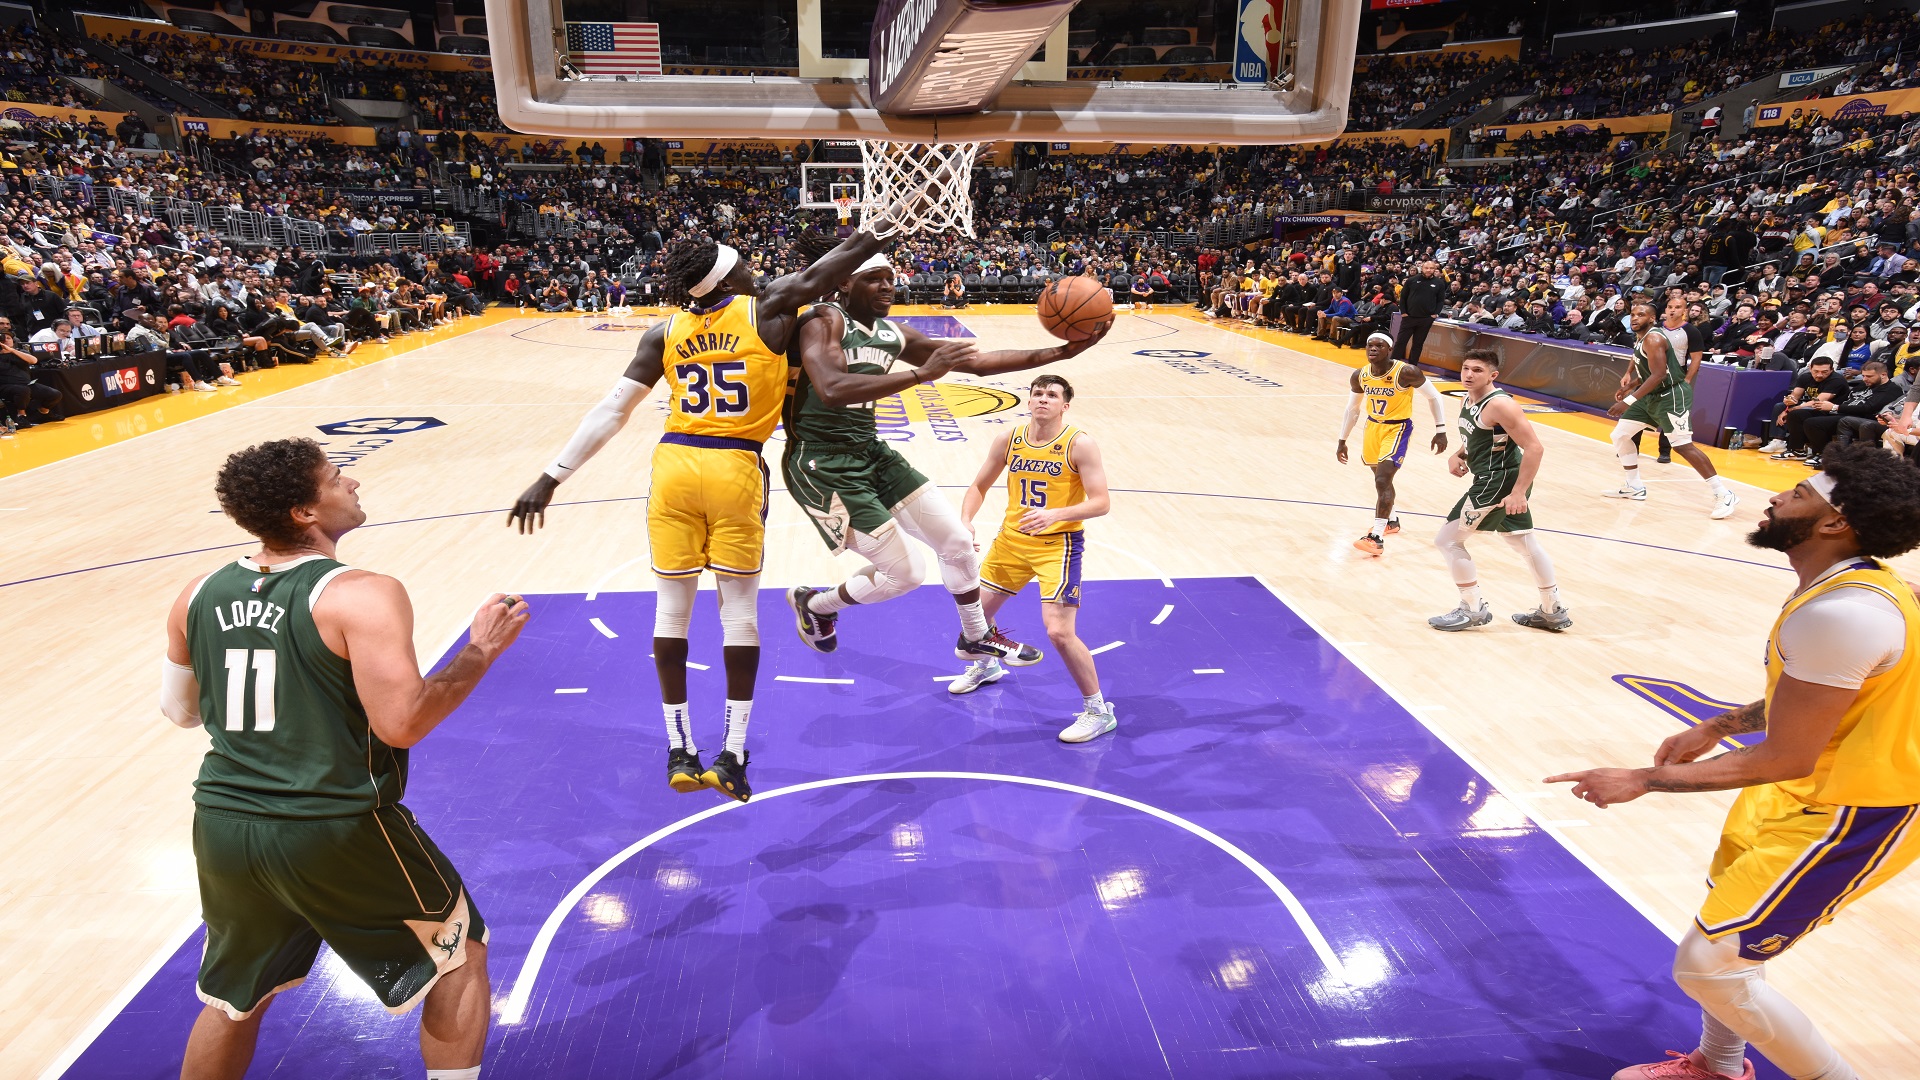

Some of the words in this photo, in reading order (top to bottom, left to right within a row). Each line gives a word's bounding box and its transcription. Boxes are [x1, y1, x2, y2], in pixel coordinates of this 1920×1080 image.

[219, 37, 319, 56] NGELES
[1240, 62, 1262, 78] NBA
[1791, 74, 1812, 83] UCLA
[1763, 109, 1777, 118] 118
[187, 122, 205, 131] 114
[675, 333, 740, 359] GABRIEL
[81, 390, 95, 398] TNT
[675, 360, 751, 418] 35
[915, 388, 944, 403] LOS
[1364, 384, 1395, 397] LAKERS
[1370, 398, 1388, 416] 17
[922, 402, 969, 443] ANGELES
[1014, 436, 1021, 444] 6
[1009, 454, 1063, 477] LAKERS
[1020, 478, 1048, 509] 15
[215, 600, 285, 635] LOPEZ
[224, 648, 277, 732] 11
